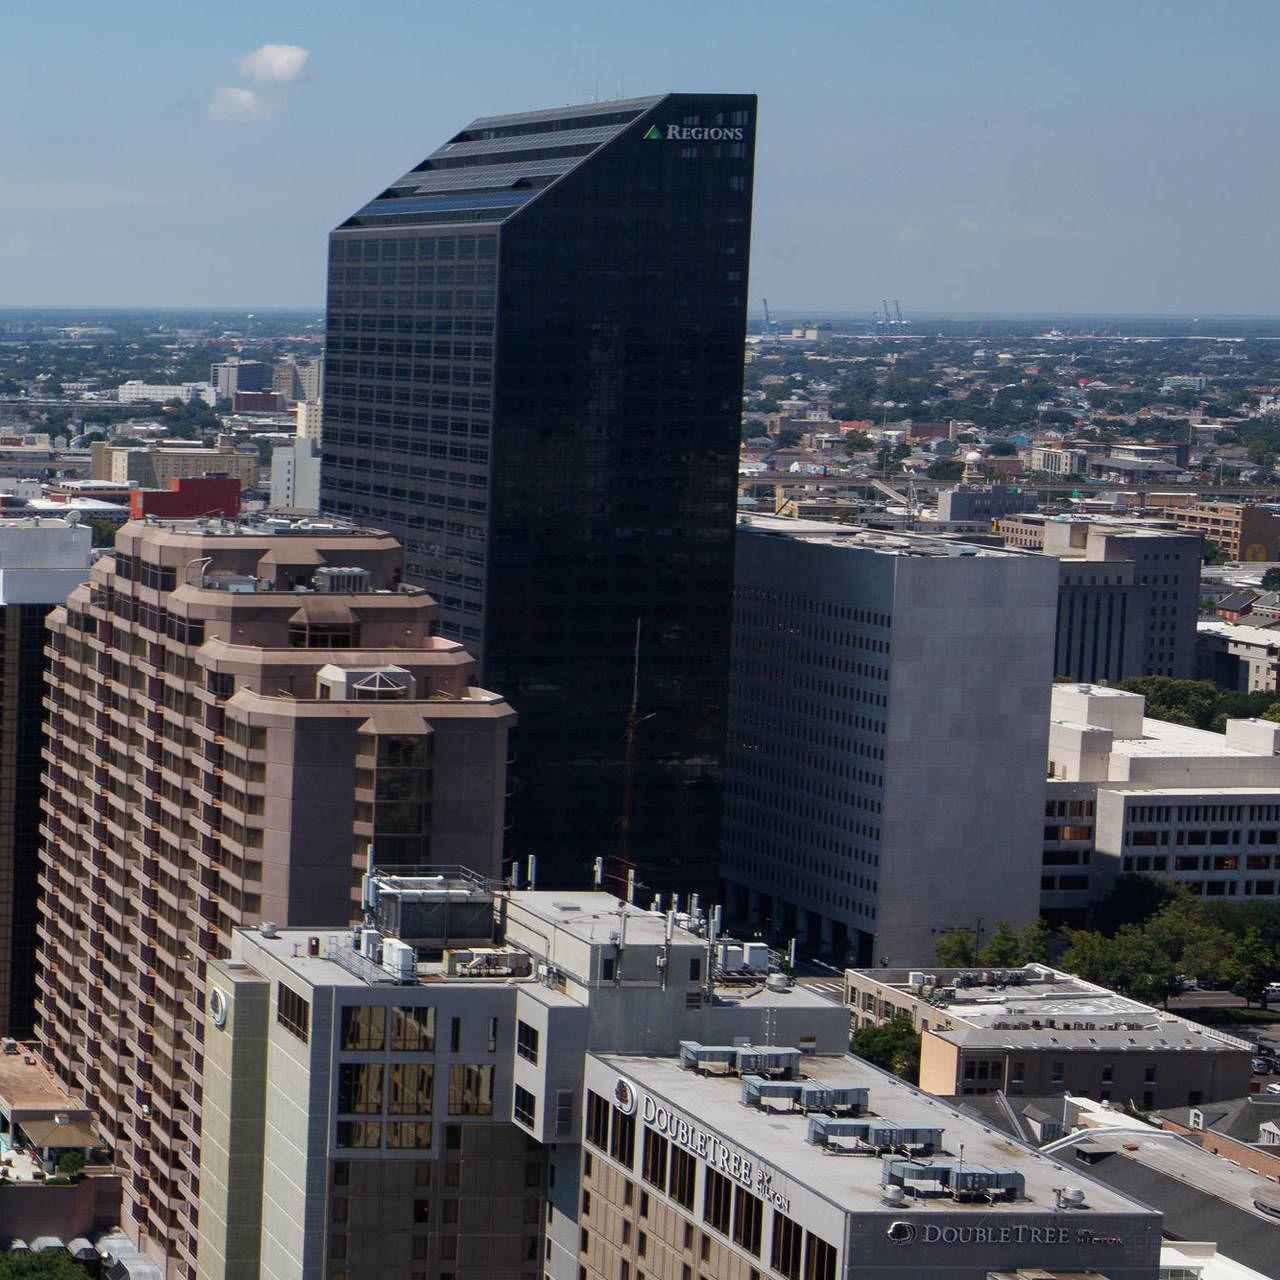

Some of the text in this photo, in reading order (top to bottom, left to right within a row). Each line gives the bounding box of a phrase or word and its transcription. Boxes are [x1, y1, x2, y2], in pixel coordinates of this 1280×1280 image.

[666, 124, 744, 140] REGIONS
[642, 1093, 753, 1188] DOUBLETREE
[923, 1225, 1069, 1243] DOUBLETREE
